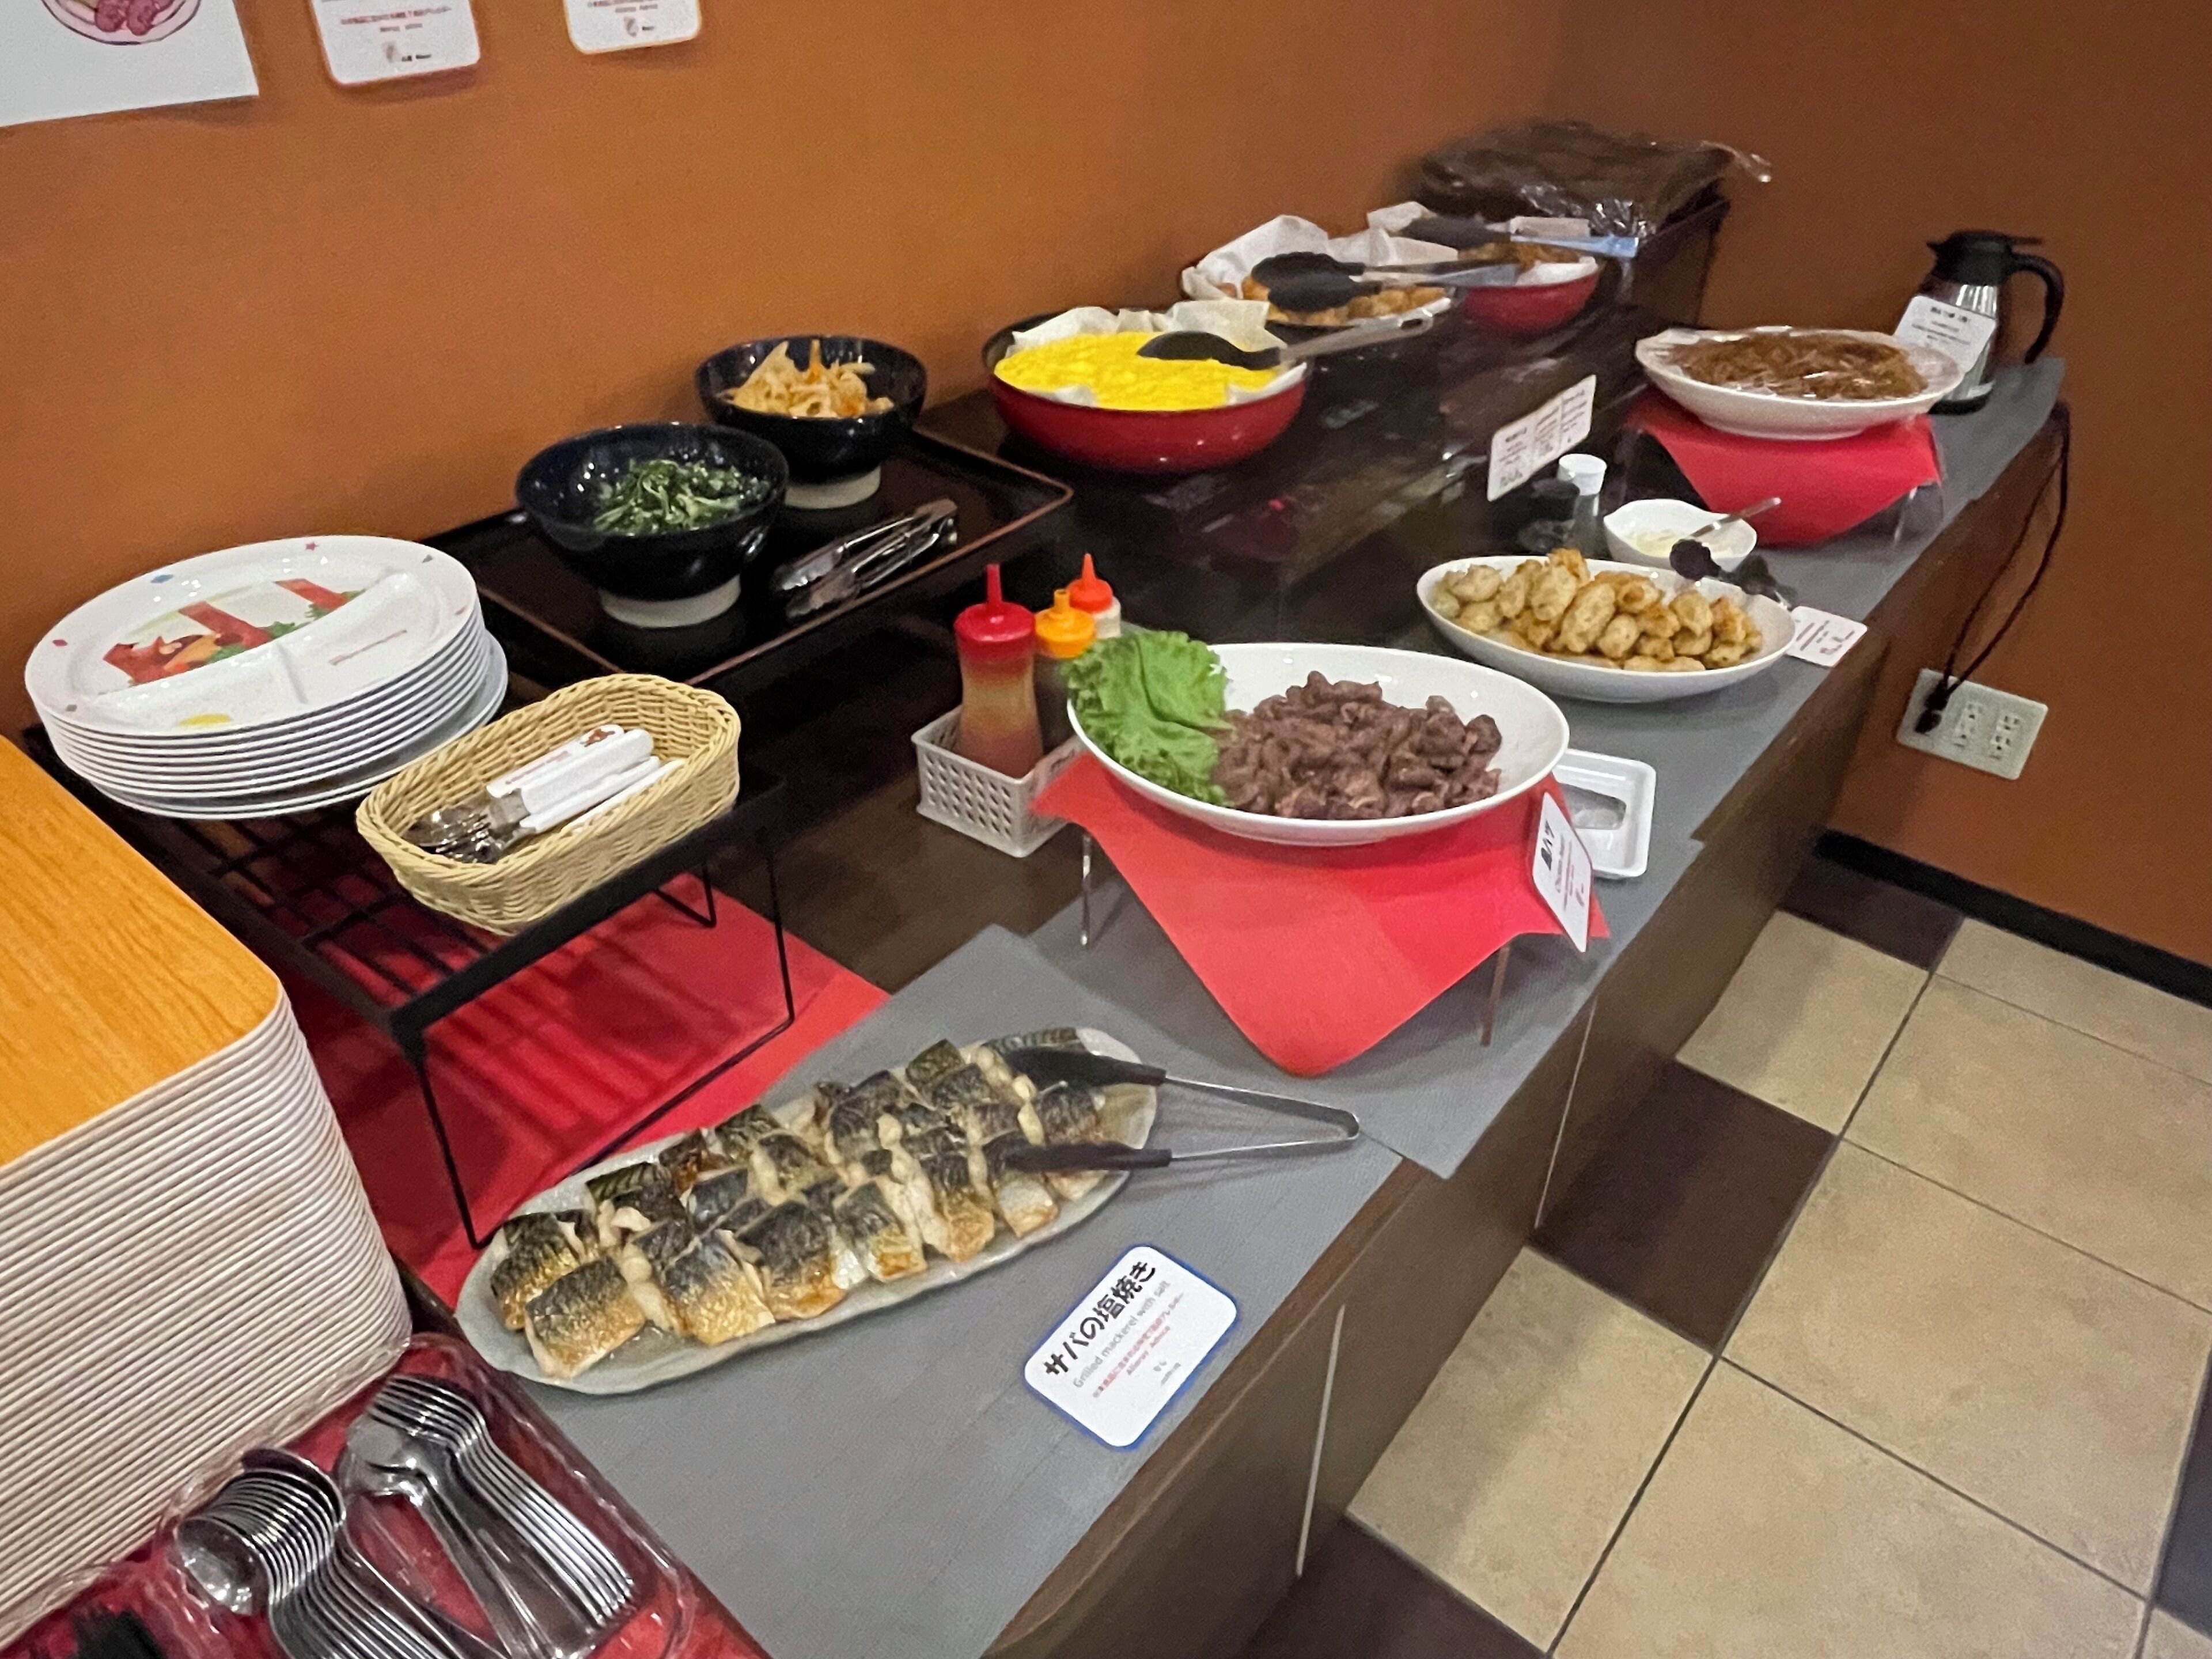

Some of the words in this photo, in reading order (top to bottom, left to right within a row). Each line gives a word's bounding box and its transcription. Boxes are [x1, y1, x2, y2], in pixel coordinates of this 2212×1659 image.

[1044, 1261, 1156, 1375] サバの塩焼き
[1073, 1355, 1103, 1388] Grilled
[1101, 1315, 1138, 1358] mackerel
[1137, 1297, 1156, 1317] with
[1153, 1280, 1171, 1297] salt
